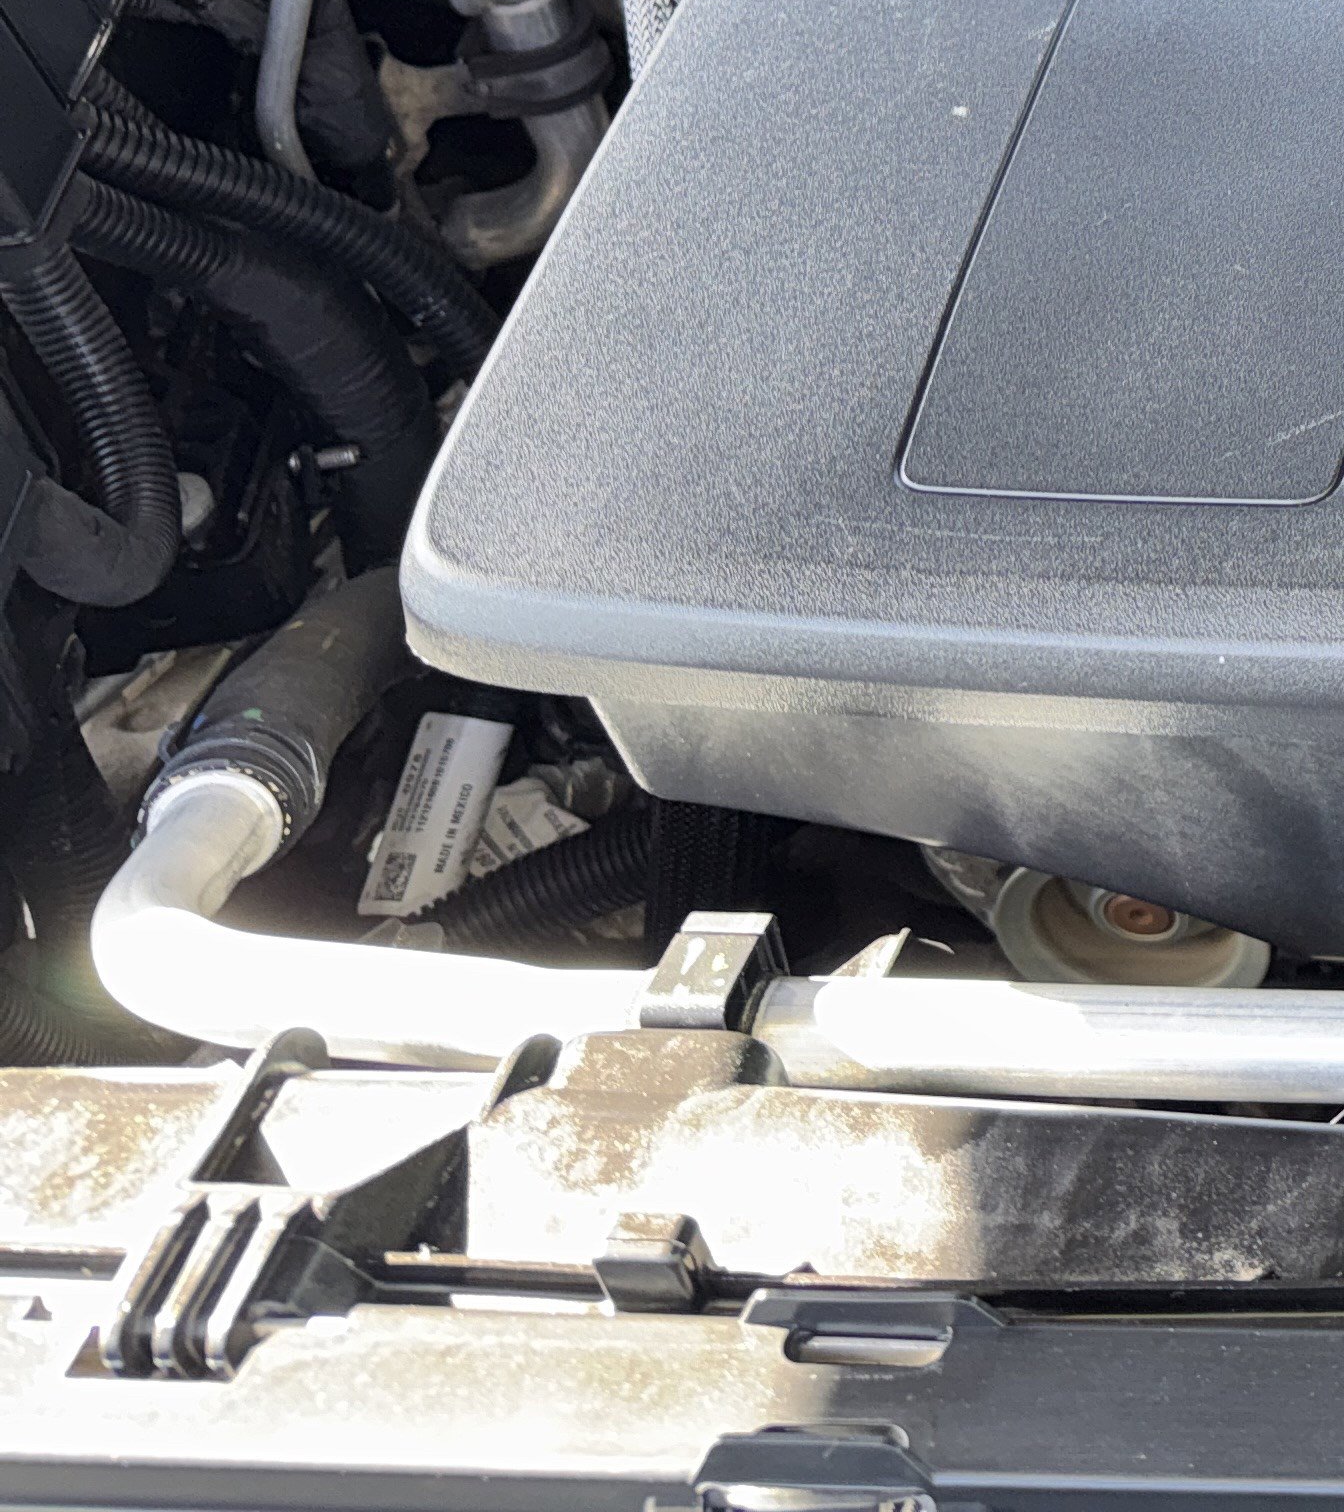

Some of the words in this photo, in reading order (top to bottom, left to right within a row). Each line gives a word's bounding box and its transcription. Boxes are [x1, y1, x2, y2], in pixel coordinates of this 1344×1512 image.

[451, 782, 472, 825] MEXICO
[446, 820, 458, 840] IN
[433, 838, 453, 874] MADE
